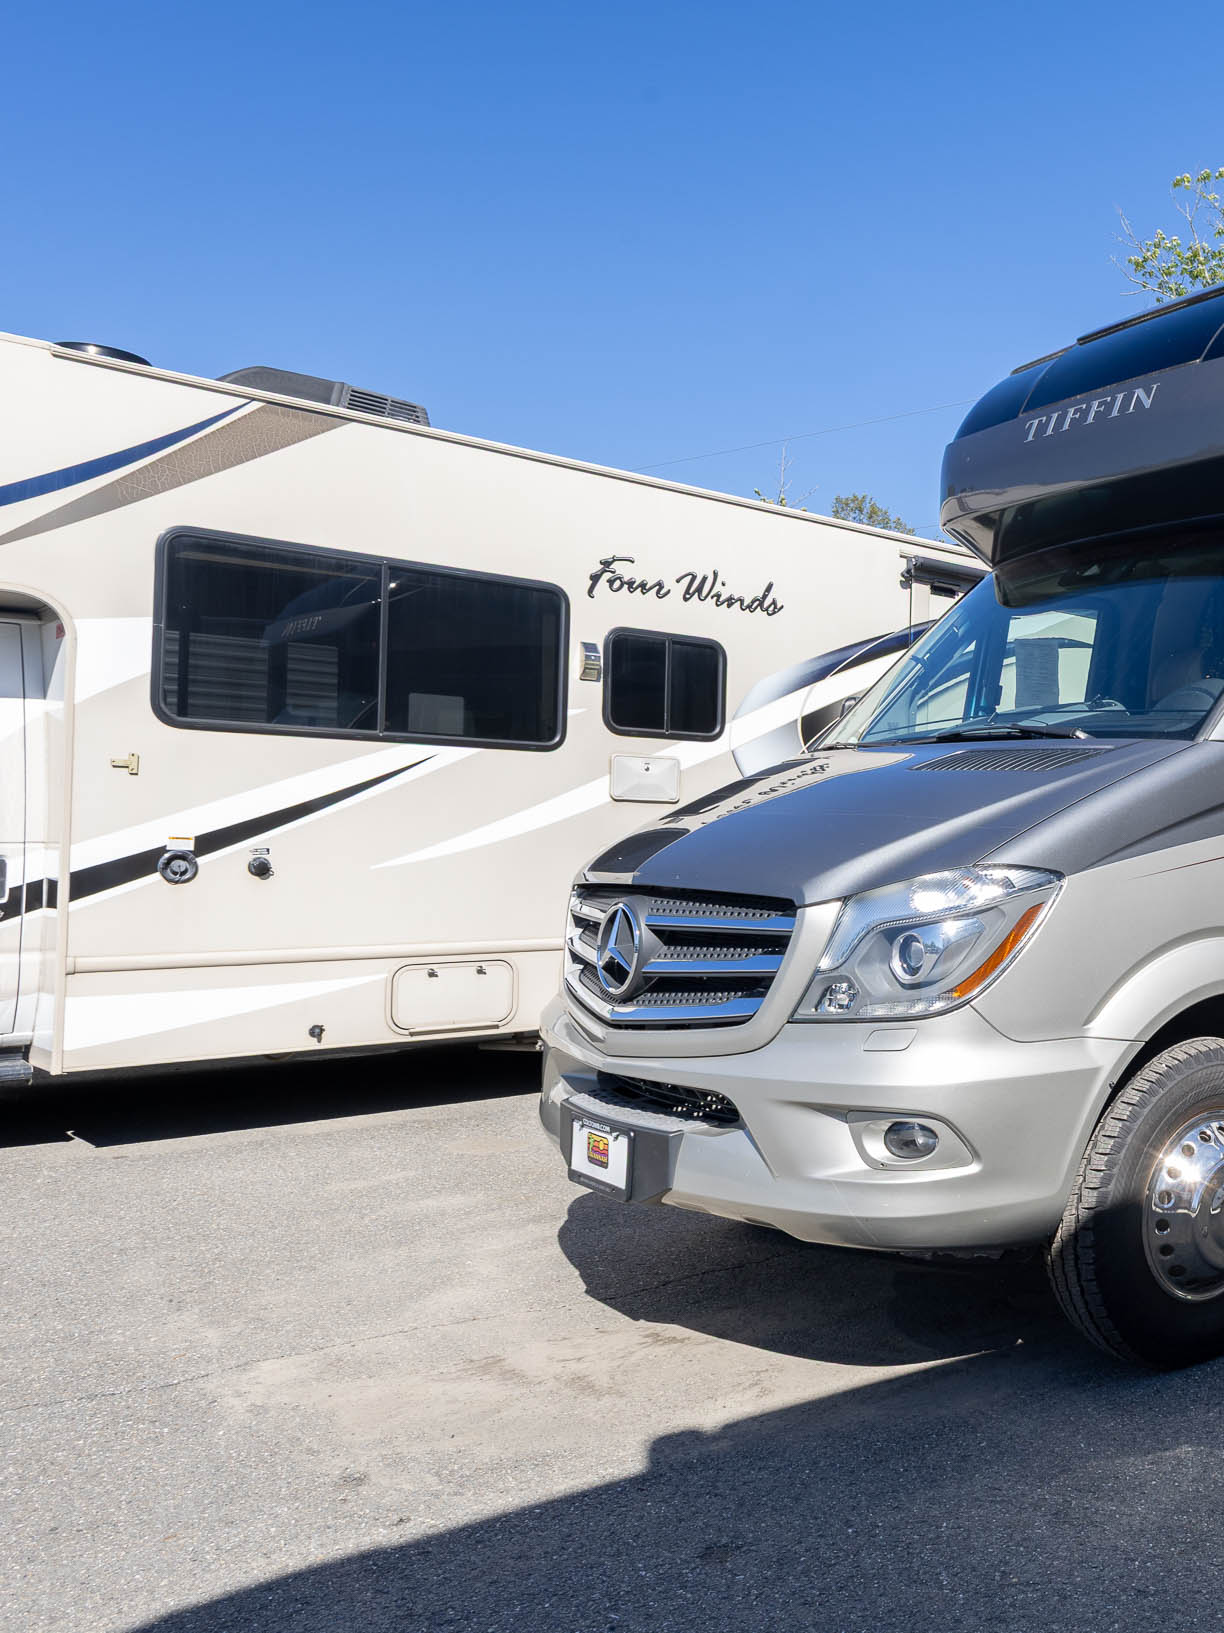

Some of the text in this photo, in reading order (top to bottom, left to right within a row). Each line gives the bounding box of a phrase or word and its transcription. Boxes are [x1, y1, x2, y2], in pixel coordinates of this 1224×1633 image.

[1023, 382, 1161, 444] TIFFIN
[587, 555, 785, 617] Four Winds
